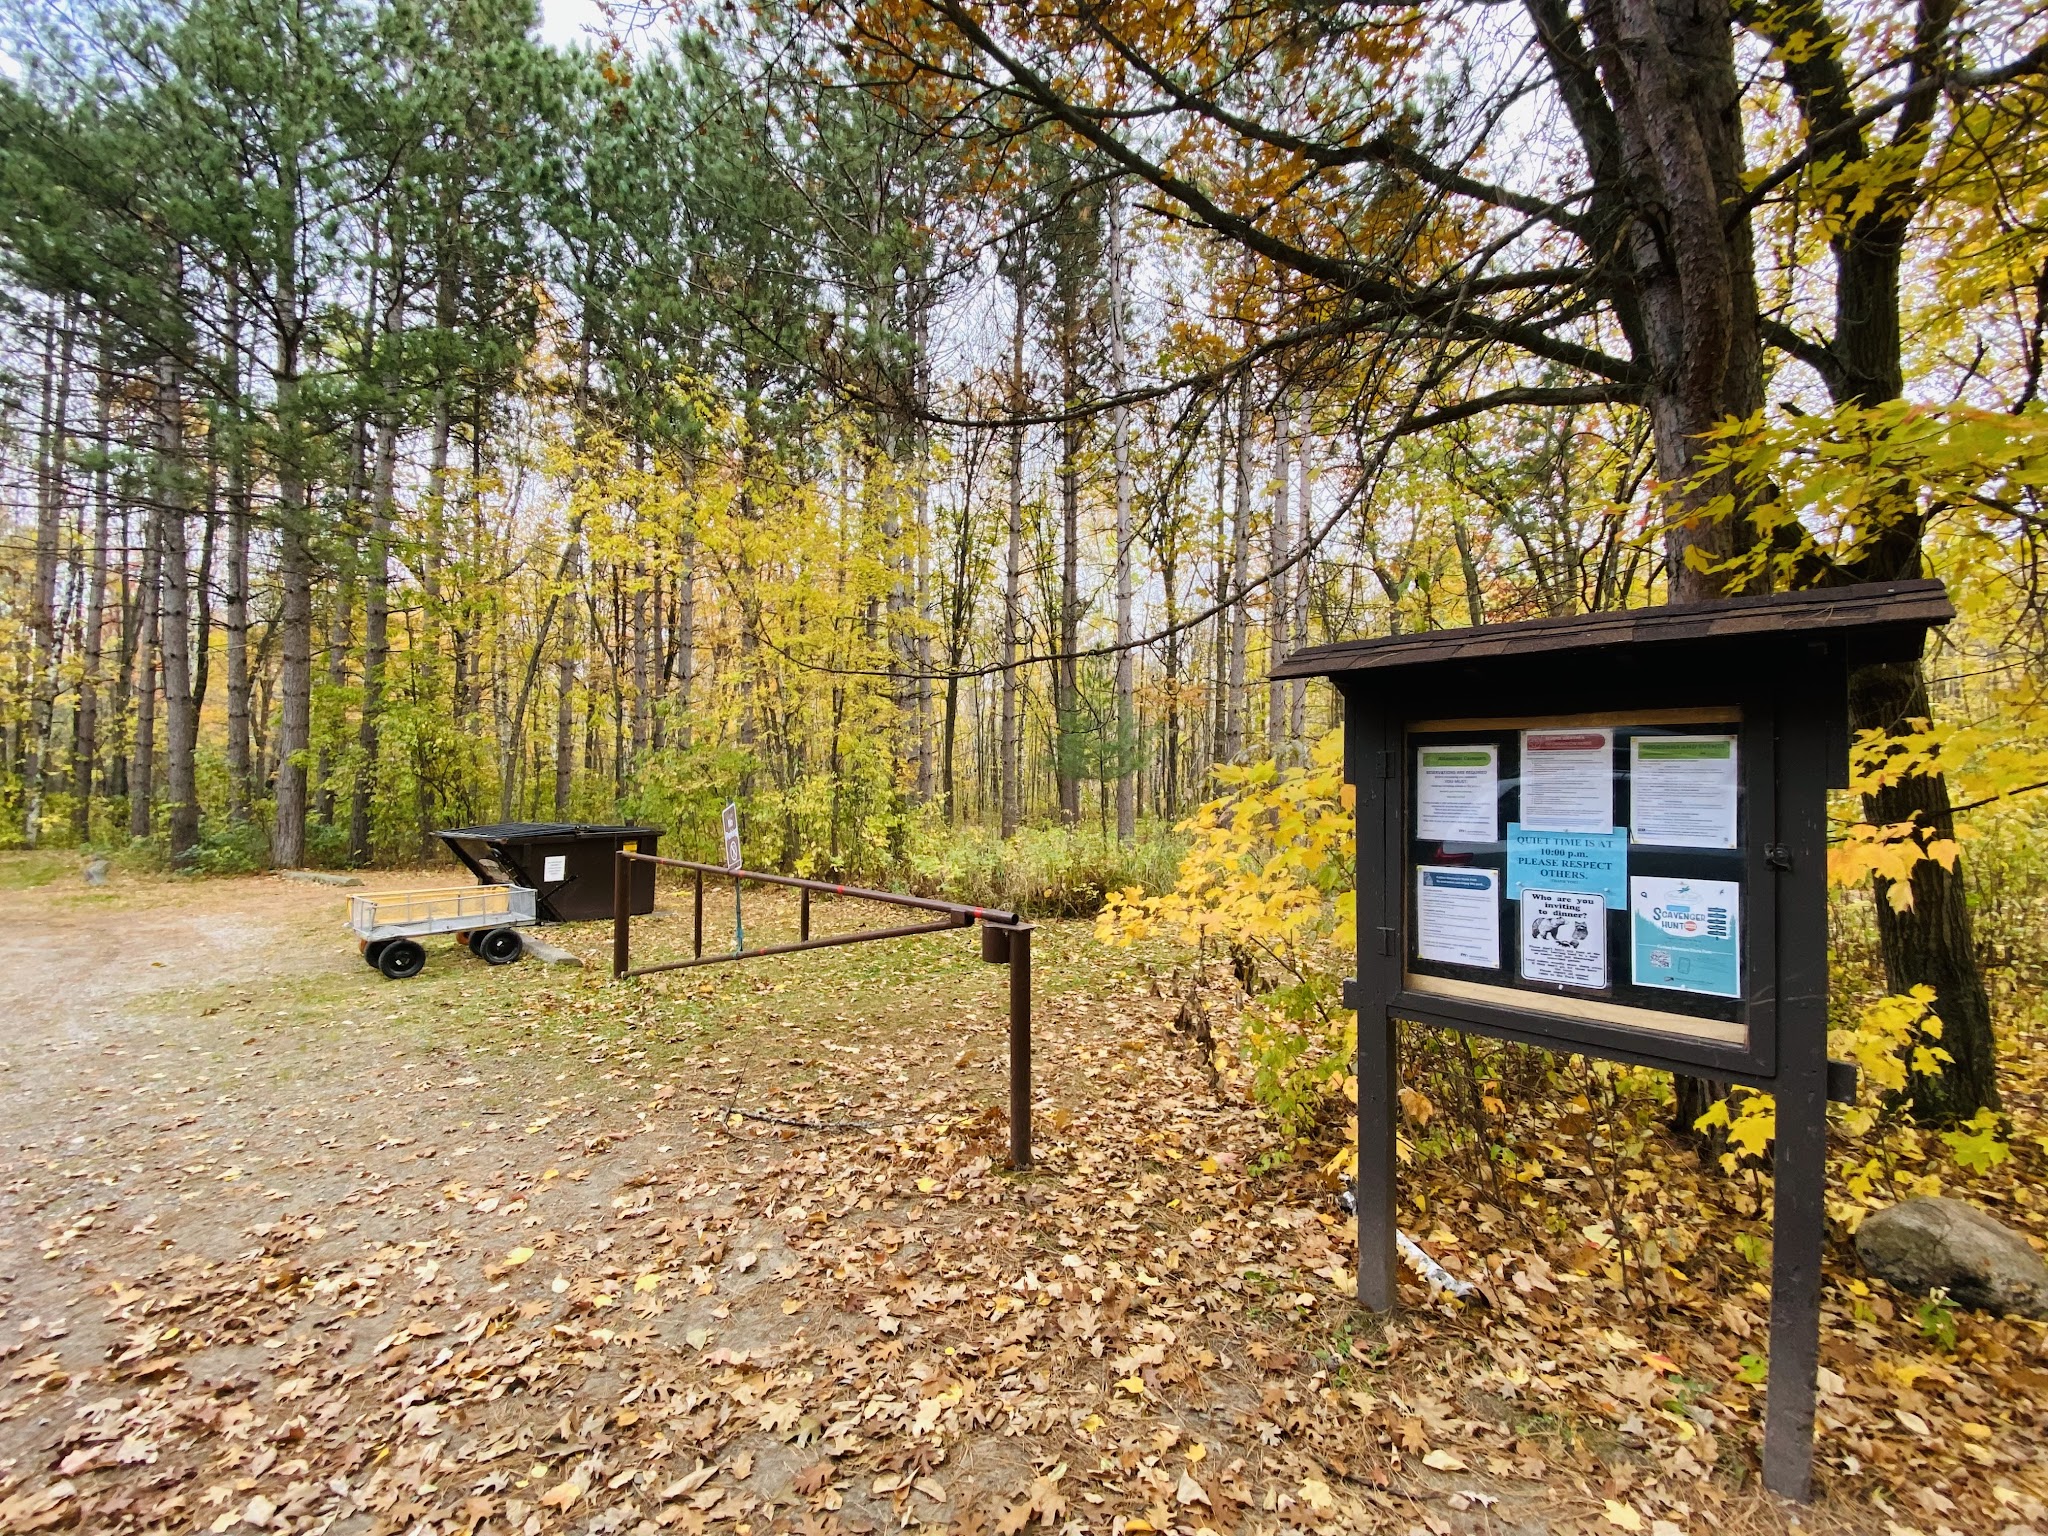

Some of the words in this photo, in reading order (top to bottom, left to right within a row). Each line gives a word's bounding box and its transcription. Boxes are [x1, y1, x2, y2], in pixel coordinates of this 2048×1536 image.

[1517, 836, 1549, 845] QUIET
[1554, 838, 1582, 847] TIME
[1585, 839, 1595, 847] IS
[1597, 840, 1614, 848] AT
[1540, 848, 1565, 857] 10:00
[1567, 850, 1589, 858] p.m.
[1518, 857, 1559, 867] PLEASE
[1561, 860, 1613, 870] RESPECT
[1540, 869, 1589, 880] OTHERS.
[1532, 893, 1552, 901] Who
[1545, 902, 1580, 912] inviting
[1553, 910, 1588, 918] dinner?
[1653, 907, 1706, 921] SCAVENGER
[1661, 920, 1685, 930] HUNT
